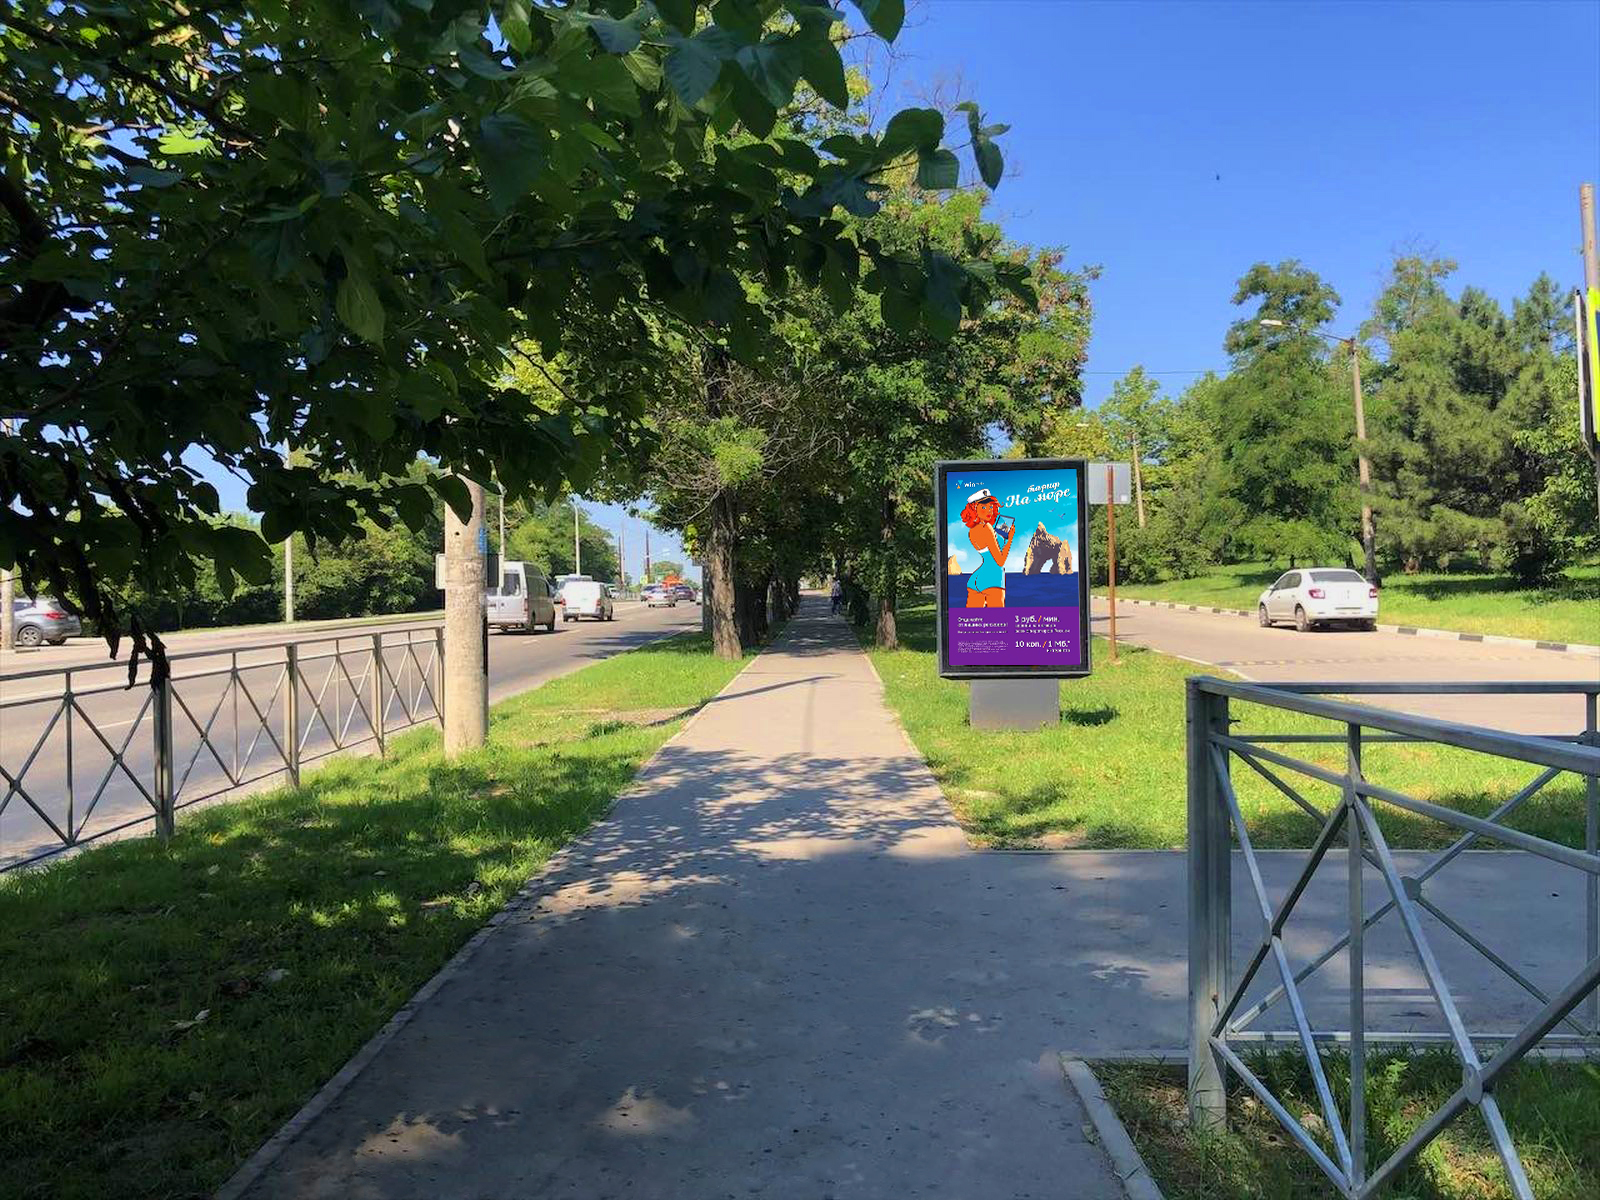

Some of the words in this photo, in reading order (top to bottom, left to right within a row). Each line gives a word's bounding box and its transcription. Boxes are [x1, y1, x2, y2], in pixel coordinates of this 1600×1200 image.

[1005, 494, 1031, 508] На
[1034, 488, 1071, 503] море
[1015, 615, 1019, 623] 3
[1021, 615, 1037, 624] руб.
[1015, 640, 1025, 648] 10
